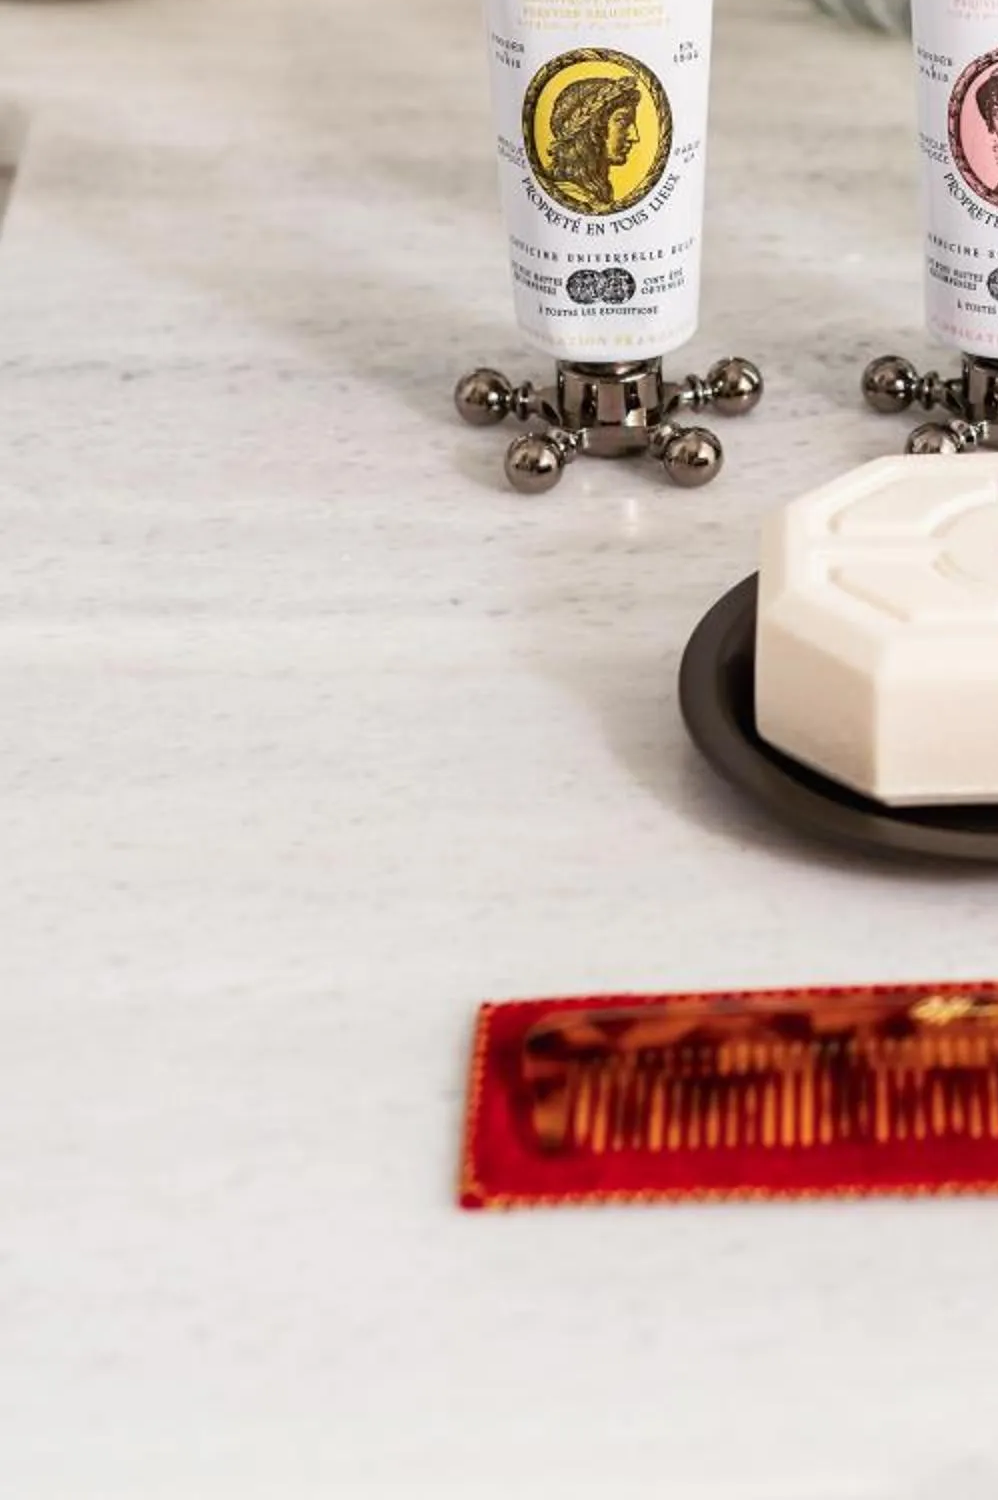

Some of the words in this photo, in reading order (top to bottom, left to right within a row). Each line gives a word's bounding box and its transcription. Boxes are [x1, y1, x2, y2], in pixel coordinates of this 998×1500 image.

[521, 177, 580, 234] PROPRETÉ
[586, 223, 605, 236] EN
[609, 211, 649, 234] TOUS
[649, 173, 680, 213] LIEUX
